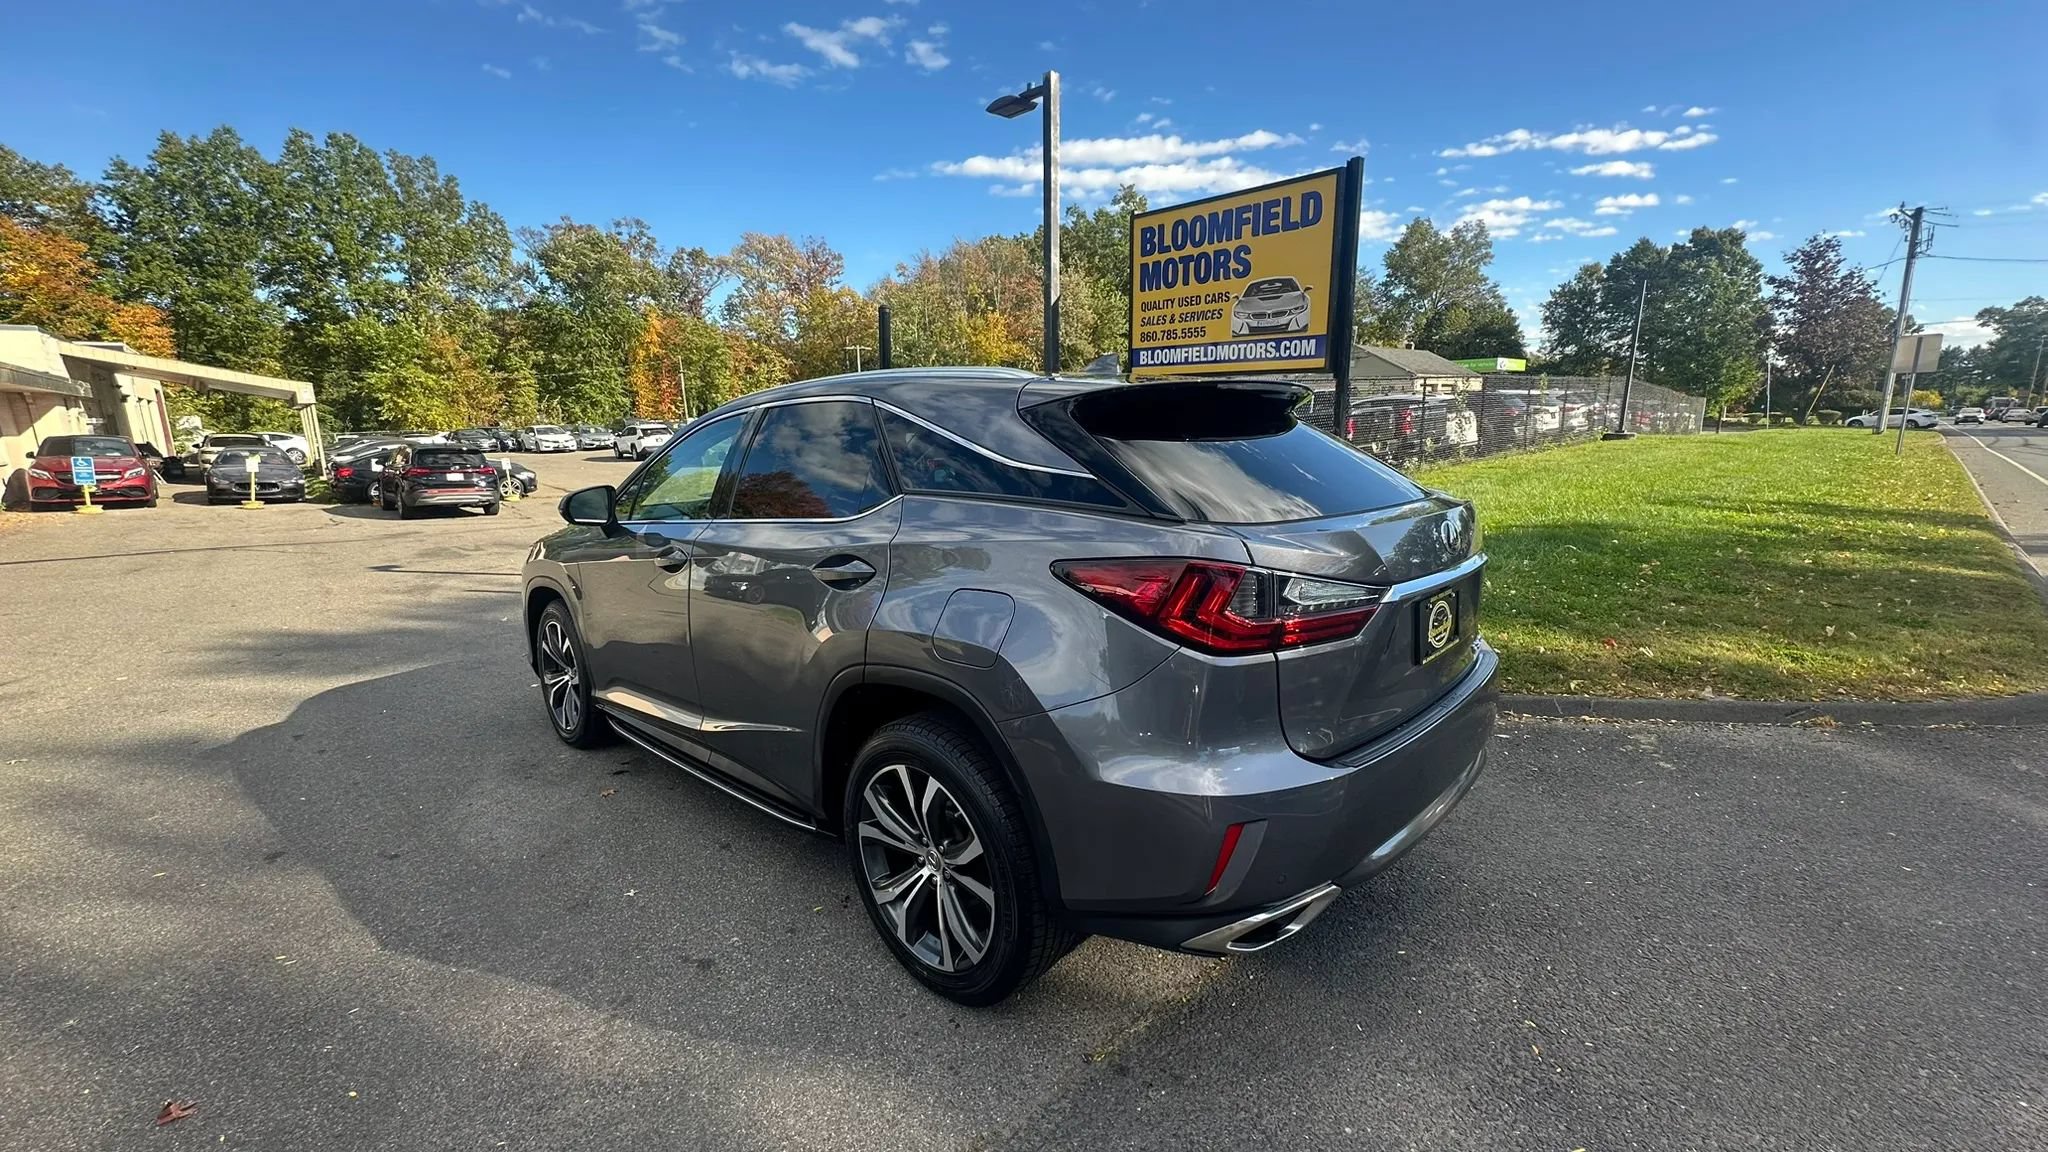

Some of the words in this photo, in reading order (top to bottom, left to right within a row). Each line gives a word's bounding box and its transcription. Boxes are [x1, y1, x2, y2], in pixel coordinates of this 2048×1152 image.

[1140, 191, 1323, 258] BLOOMFIELD
[1139, 244, 1252, 292] MOTORS
[1141, 298, 1175, 312] QUALITY
[1178, 295, 1201, 307] USED
[1204, 291, 1231, 304] CARS
[1140, 314, 1167, 327] SALES
[1169, 313, 1176, 324] &
[1178, 308, 1223, 323] SERVICES
[1140, 326, 1206, 342] 860.785.5555
[1139, 339, 1317, 365] BLOOMFIELDMOTORS.COM
